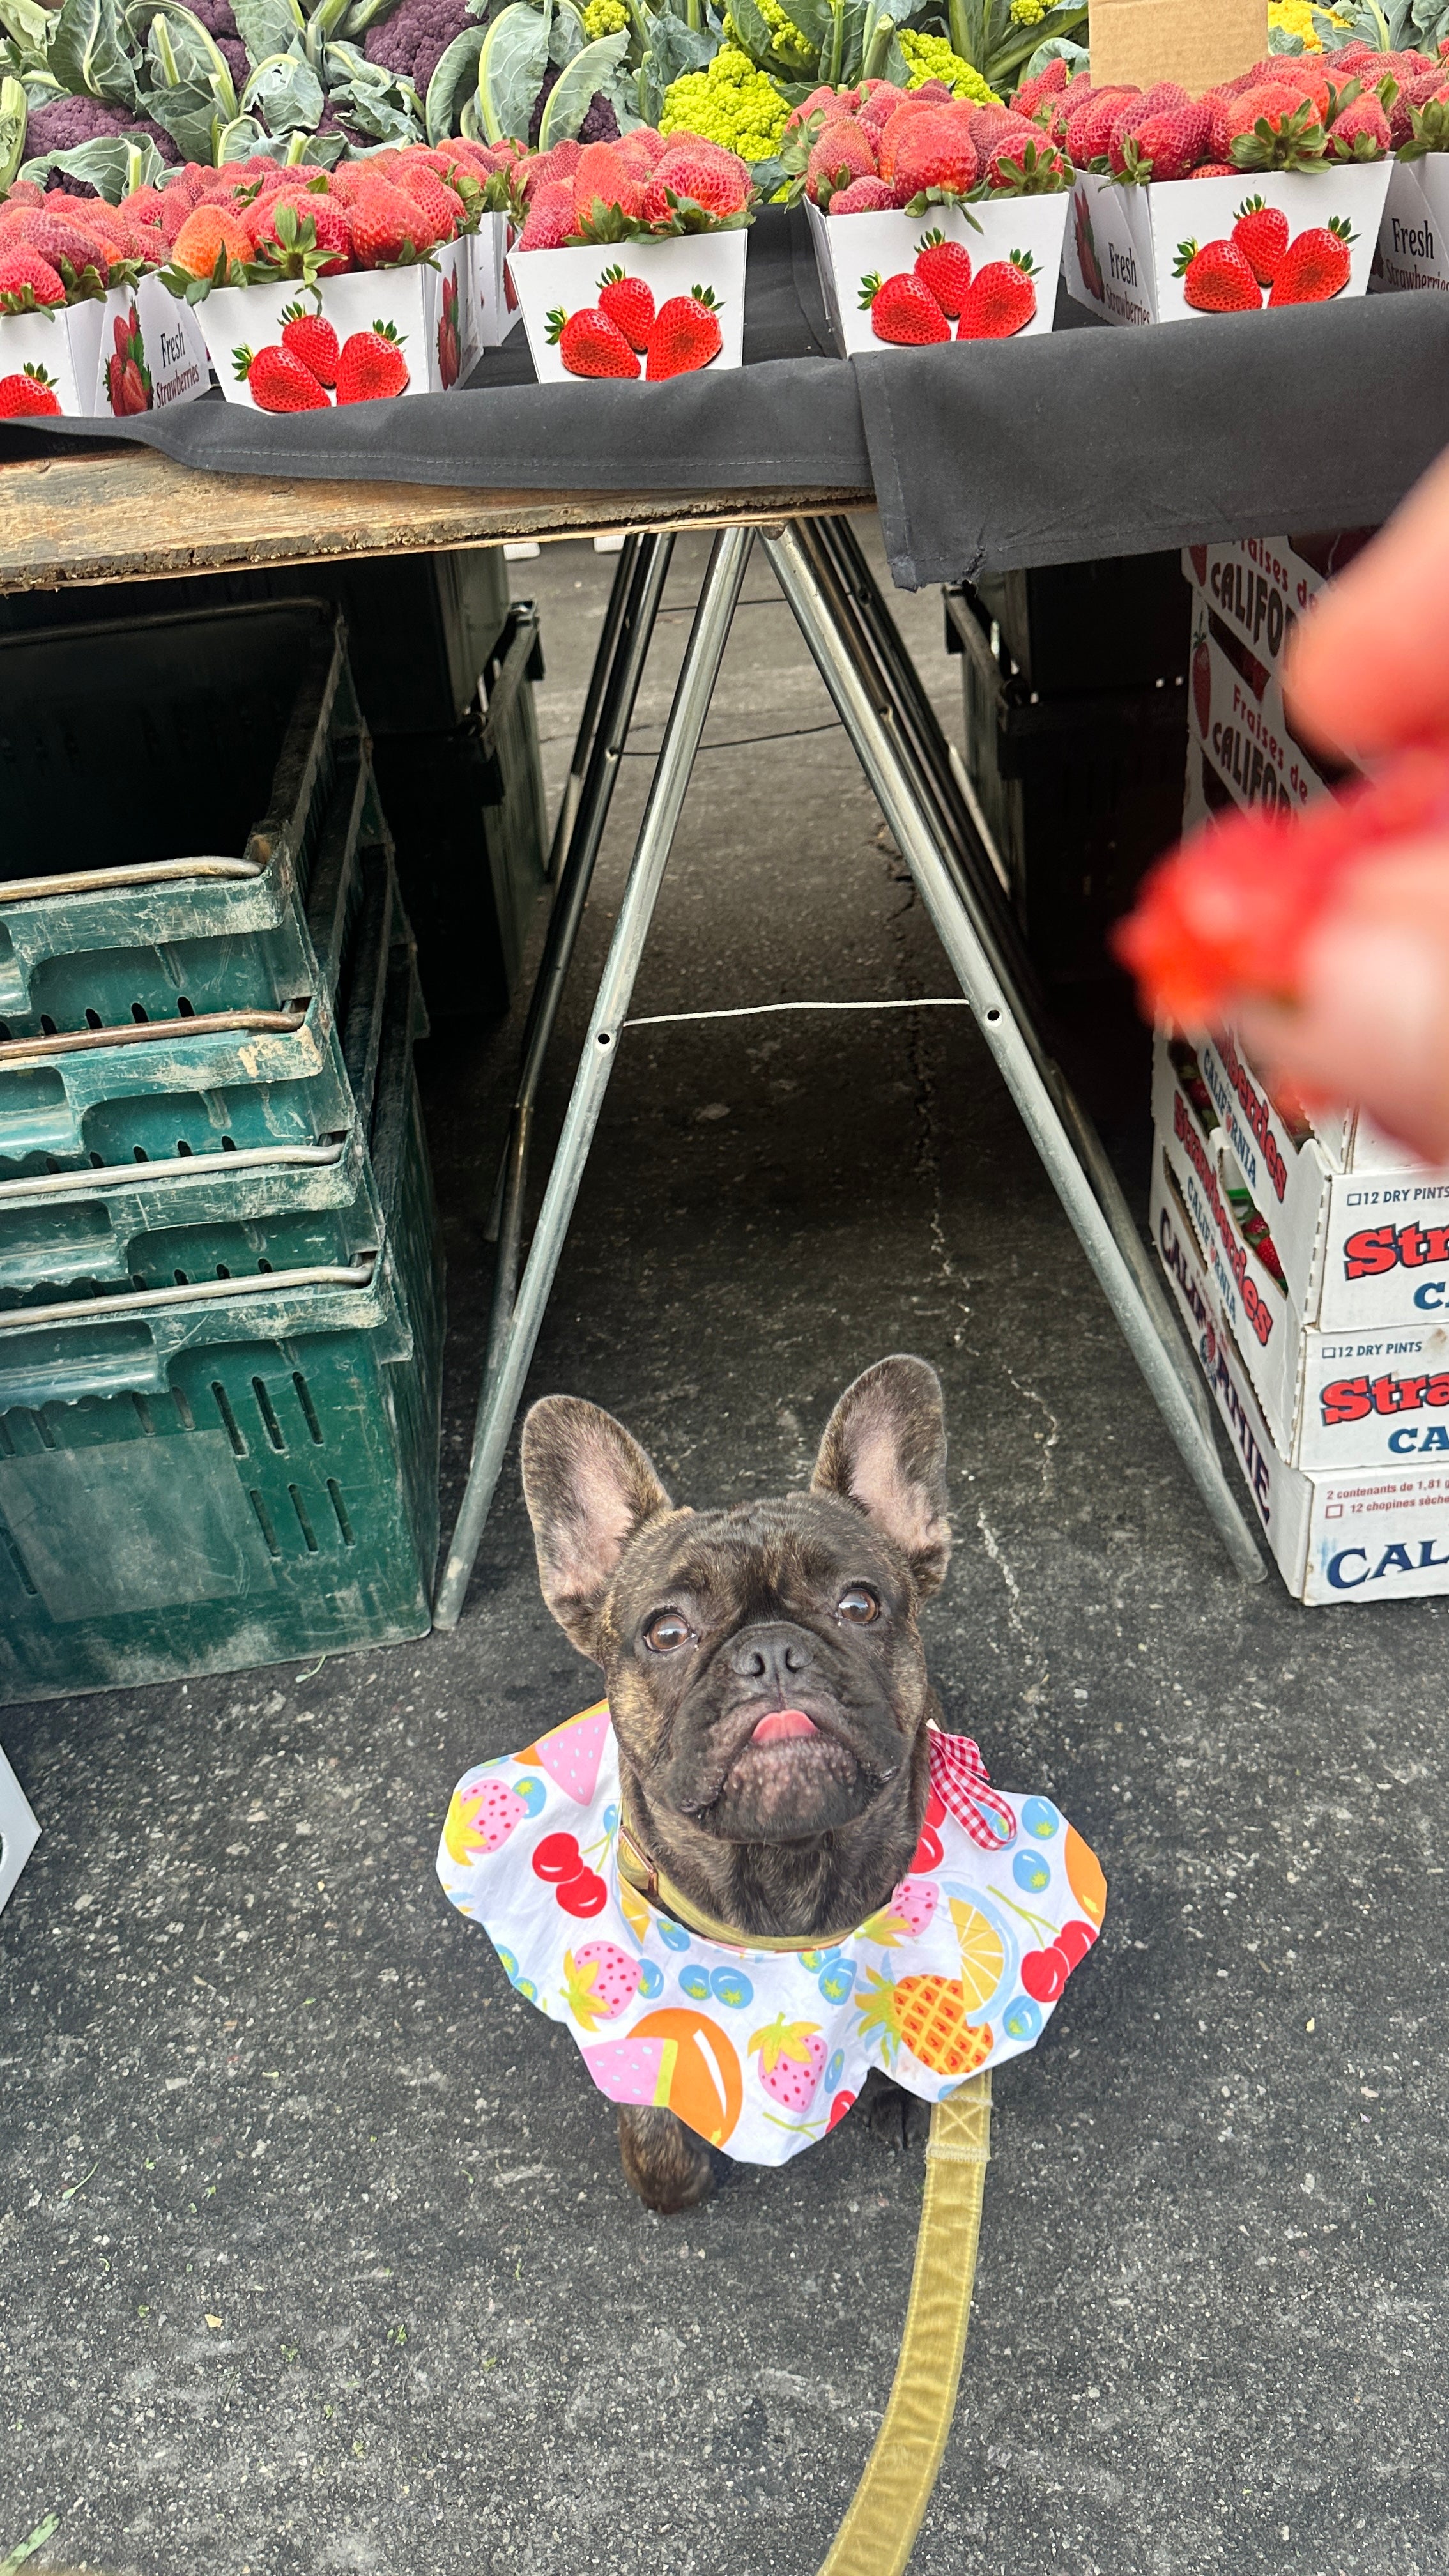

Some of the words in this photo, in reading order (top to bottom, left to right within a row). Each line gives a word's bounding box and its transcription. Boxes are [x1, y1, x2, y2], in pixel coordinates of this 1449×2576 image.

[1392, 218, 1434, 259] Fresh
[1108, 242, 1137, 288] Fresh
[160, 323, 185, 369] Fresh
[156, 361, 199, 409] Strawberries
[1211, 562, 1298, 659] CALIFO
[1234, 684, 1284, 770] Fraises
[1290, 764, 1308, 806] de
[1363, 1192, 1379, 1205] 12
[1383, 1189, 1410, 1203] DRY
[1338, 1346, 1353, 1358] 12
[1356, 1344, 1383, 1356] DRY
[1386, 1342, 1422, 1354] PINTS
[1327, 1490, 1334, 1500] 2
[1337, 1483, 1397, 1499] contenants
[1400, 1482, 1413, 1492] de
[1351, 1503, 1363, 1513] 12
[1367, 1498, 1415, 1512] chopines
